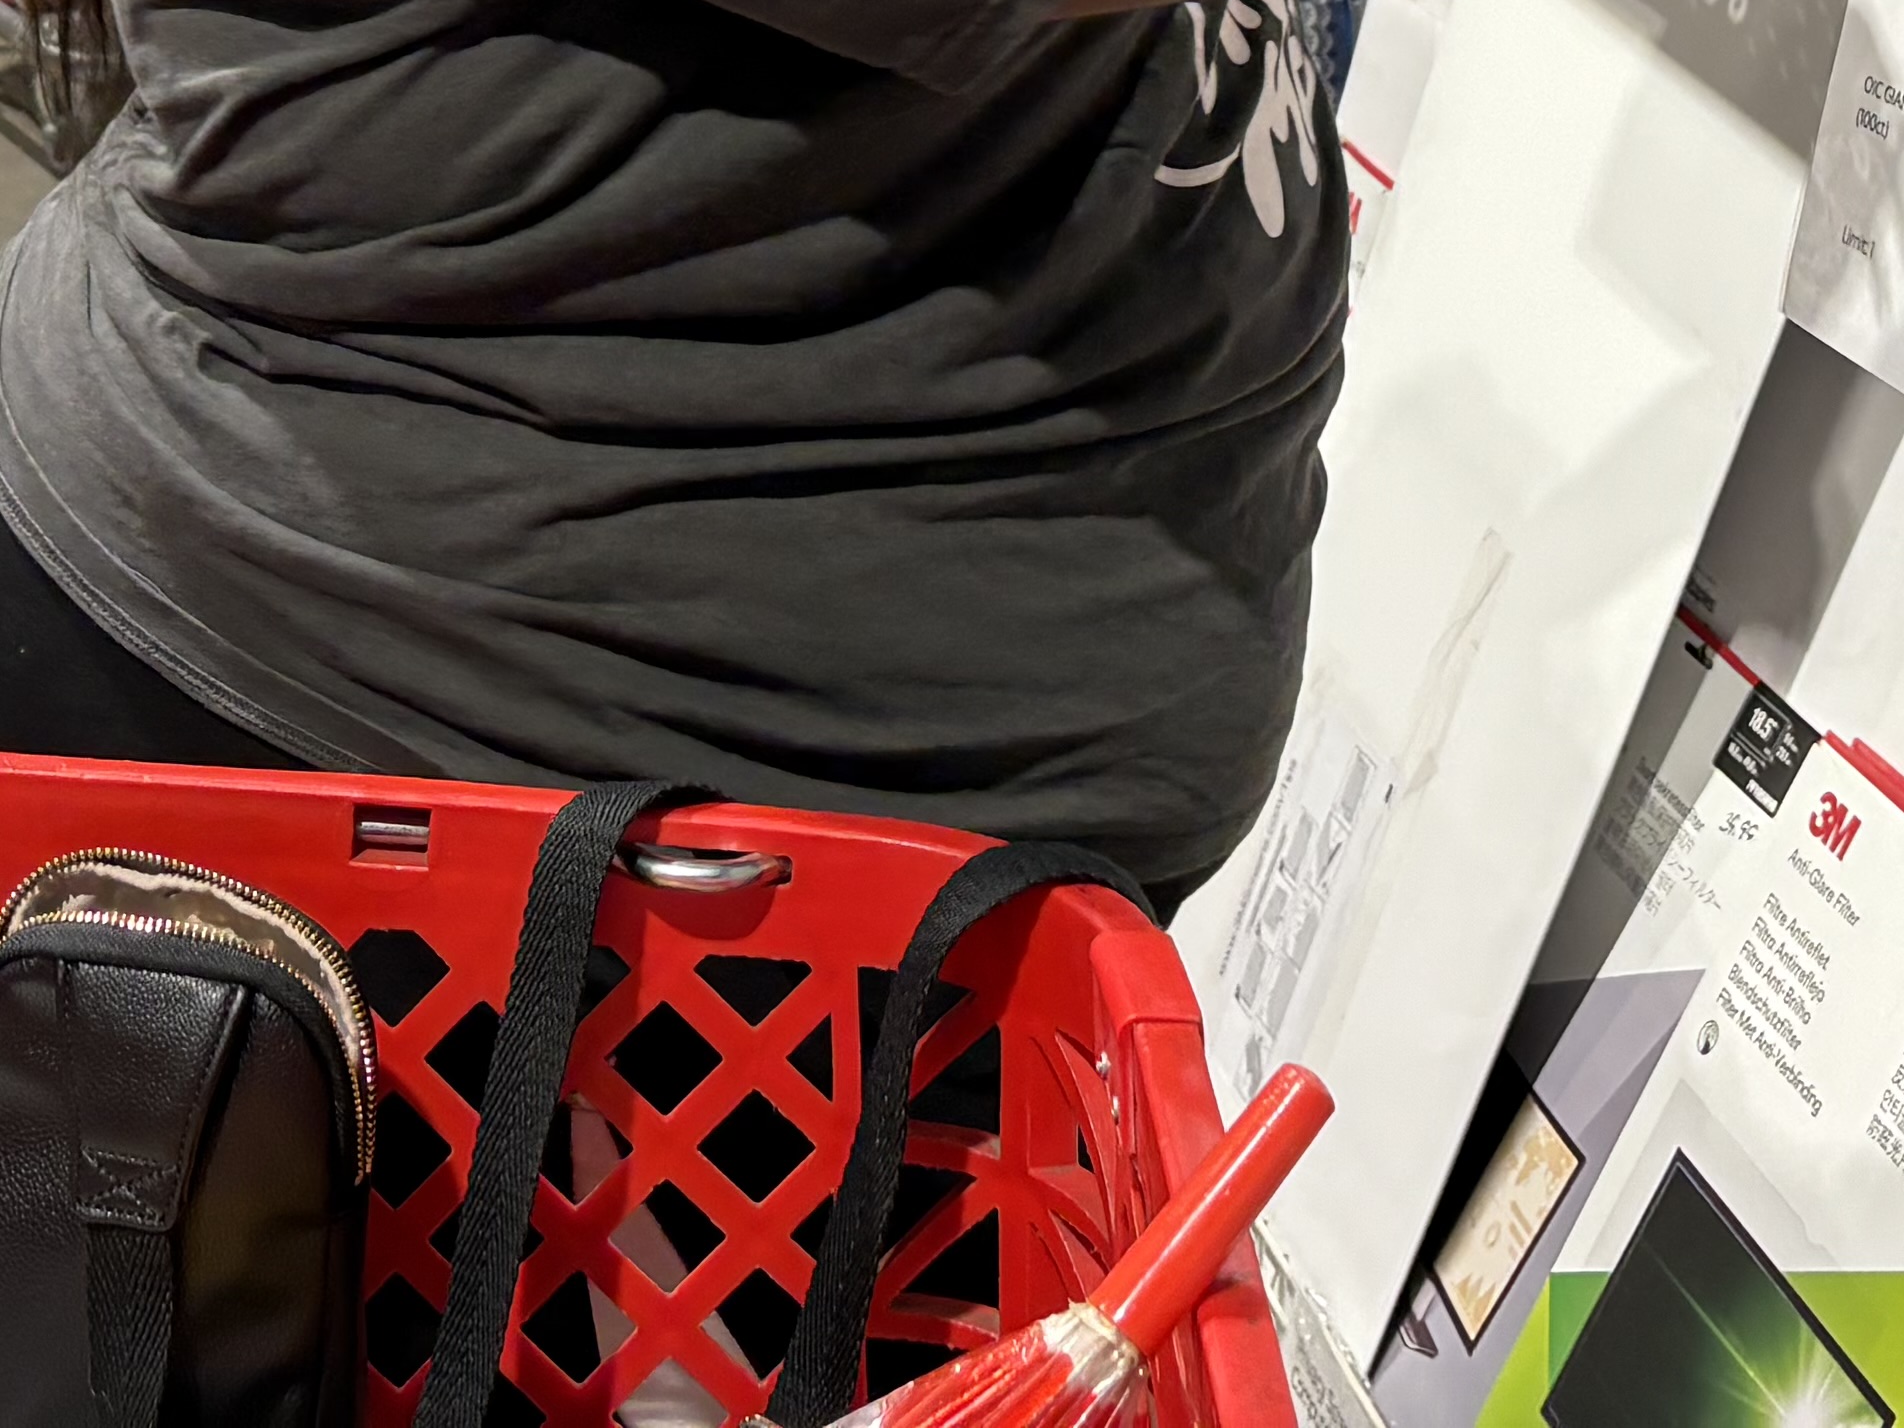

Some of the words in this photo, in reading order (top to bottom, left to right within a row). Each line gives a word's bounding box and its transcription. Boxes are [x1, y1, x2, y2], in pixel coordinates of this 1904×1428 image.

[1808, 791, 1862, 862] 3M
[1787, 848, 1834, 903] Anti-Glare
[1832, 892, 1860, 928] Filter
